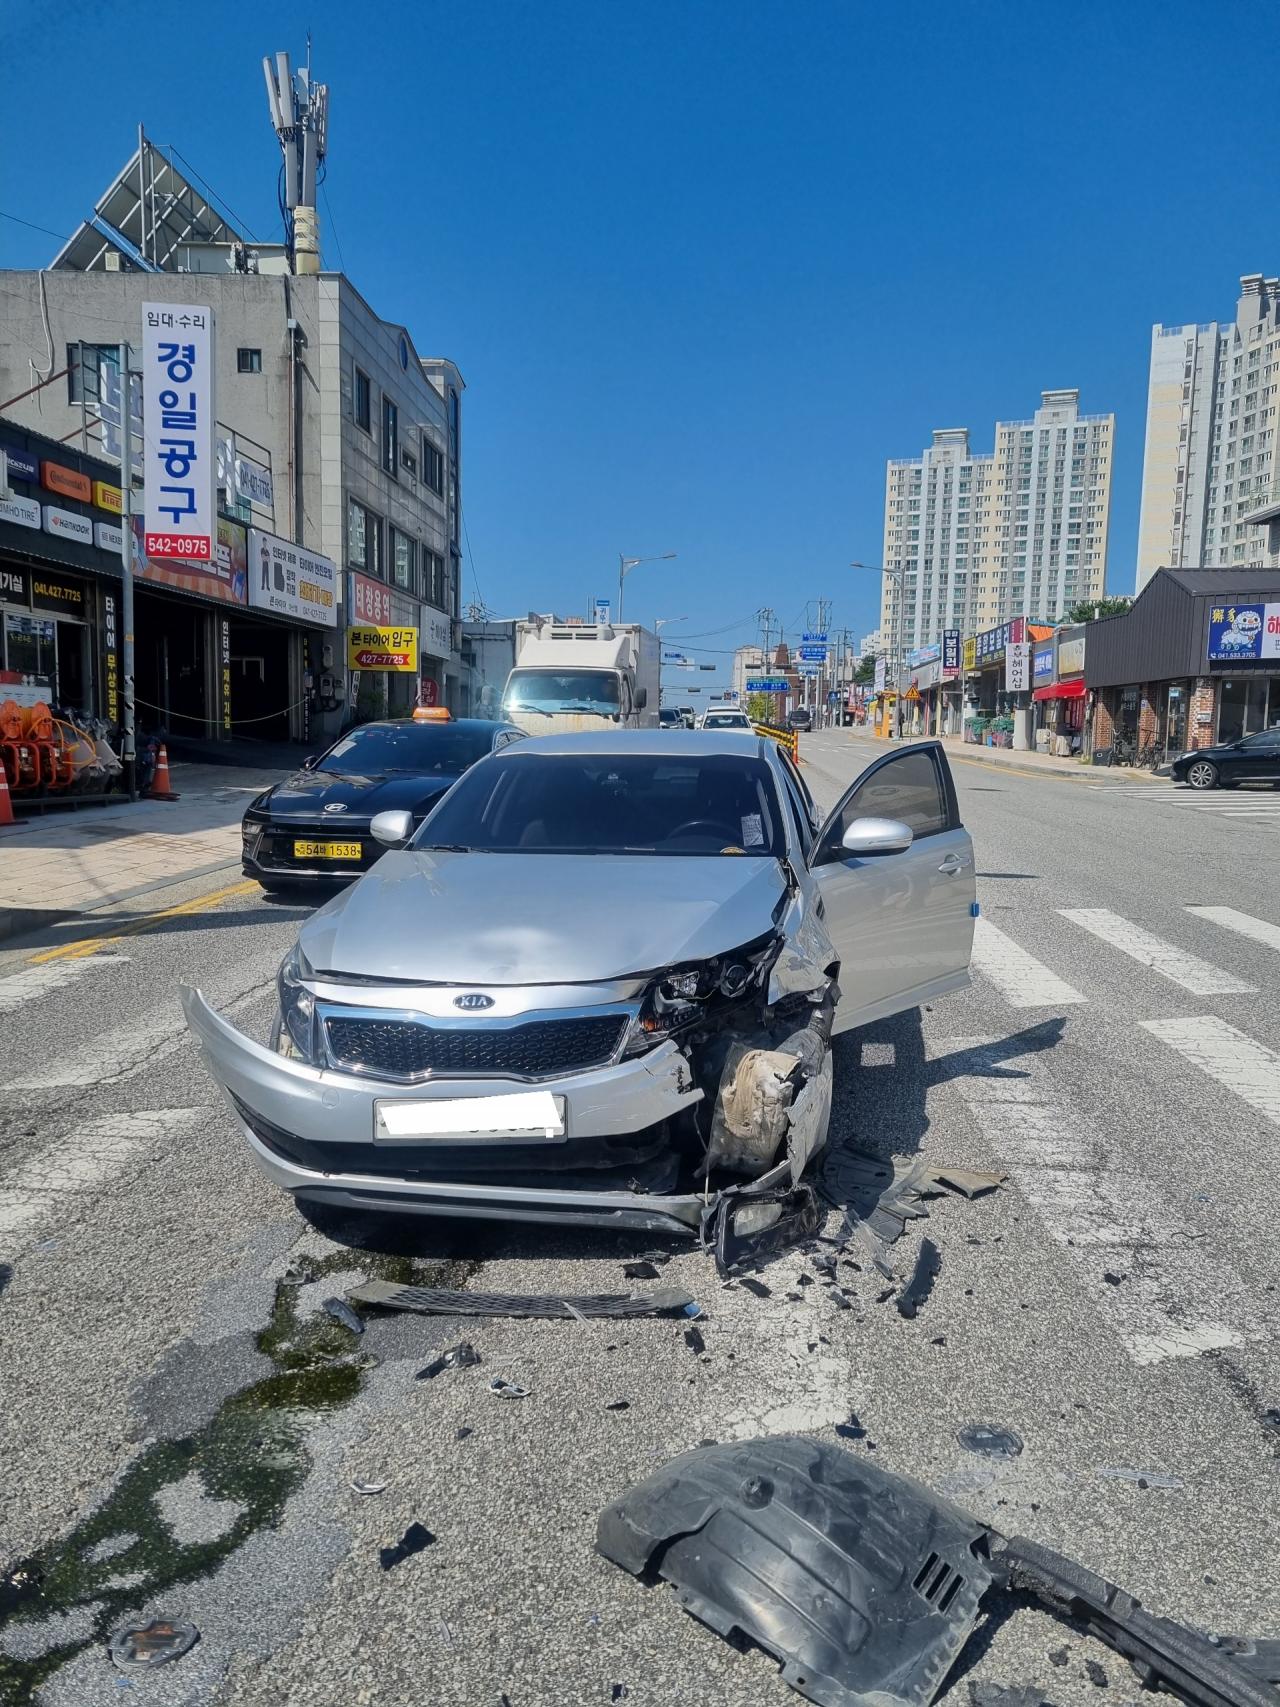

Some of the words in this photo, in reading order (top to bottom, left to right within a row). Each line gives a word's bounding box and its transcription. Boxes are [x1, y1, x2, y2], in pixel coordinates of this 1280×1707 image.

[147, 311, 206, 331] 임대·수리
[157, 342, 198, 524] 경일공구
[20, 508, 36, 522] TIRE
[148, 537, 209, 554] 542-0975
[105, 596, 115, 649] 타이어
[222, 620, 231, 664] 인터넷
[351, 632, 362, 646] 본
[363, 634, 390, 647] 타이어
[392, 631, 414, 648] 입구
[361, 653, 404, 665] 427-7725
[945, 638, 957, 667] 보일러
[1011, 659, 1023, 689] 헤어샵
[329, 844, 357, 857] 1538
[460, 996, 487, 1006] KIA
